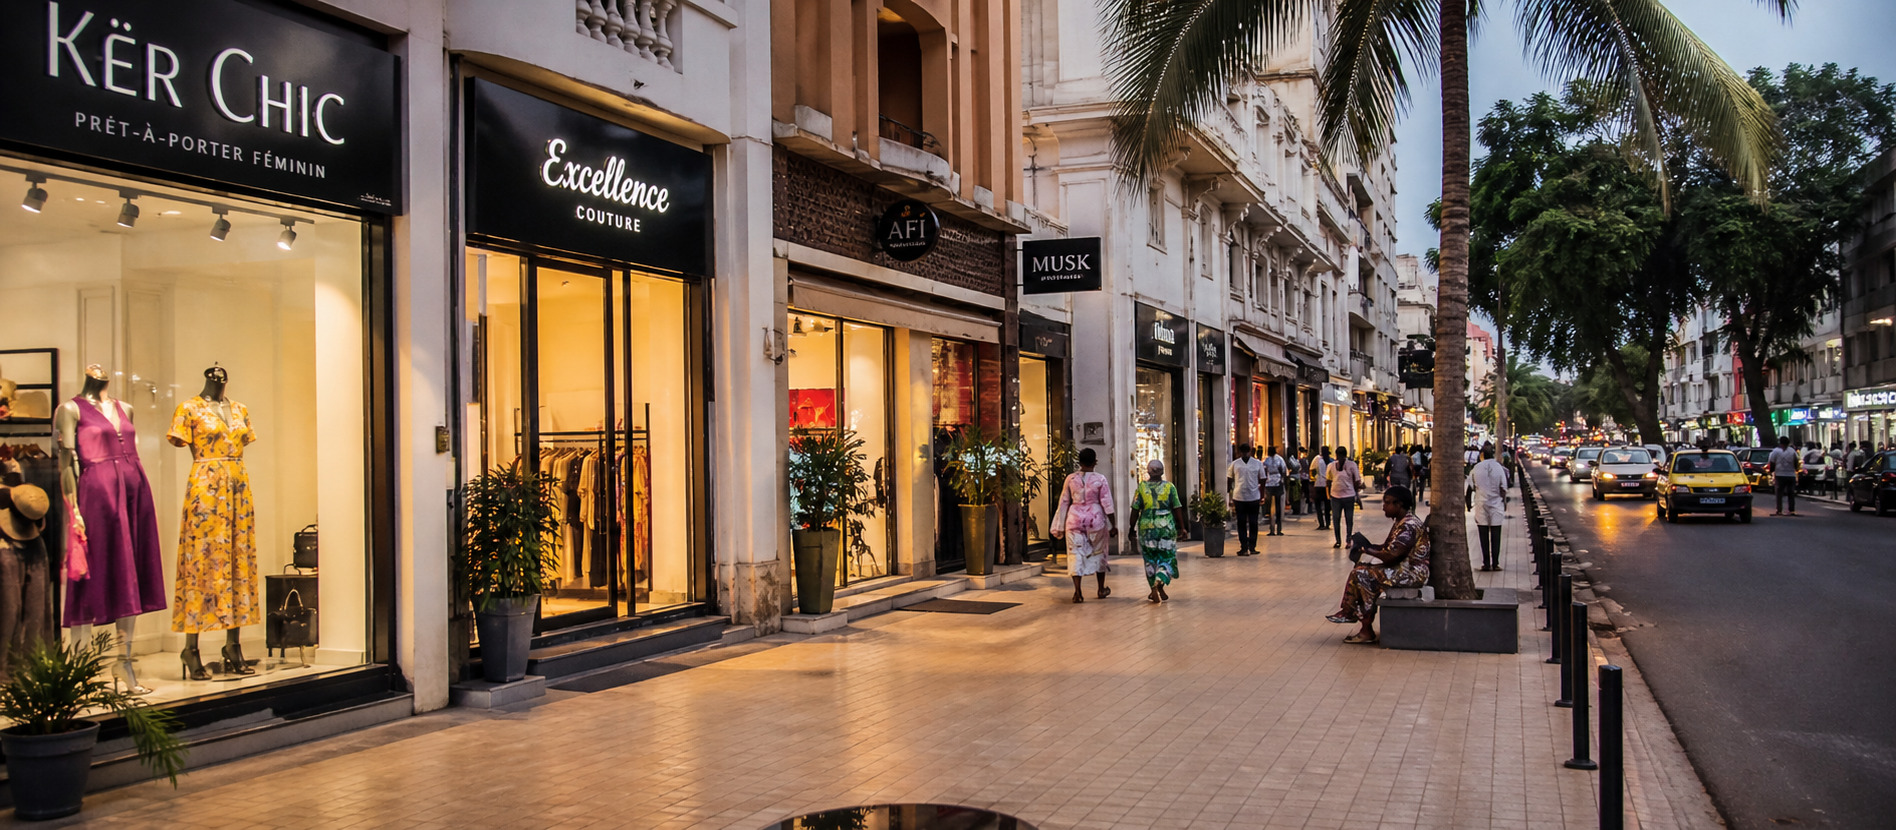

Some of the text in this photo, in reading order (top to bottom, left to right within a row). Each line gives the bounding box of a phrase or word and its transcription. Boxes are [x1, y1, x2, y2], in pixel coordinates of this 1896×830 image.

[48, 1, 345, 145] KËR CHIC
[253, 150, 326, 179] FÉMININ
[540, 138, 670, 213] Excellence
[576, 205, 641, 233] COUTURE
[1032, 253, 1091, 273] MUSK
